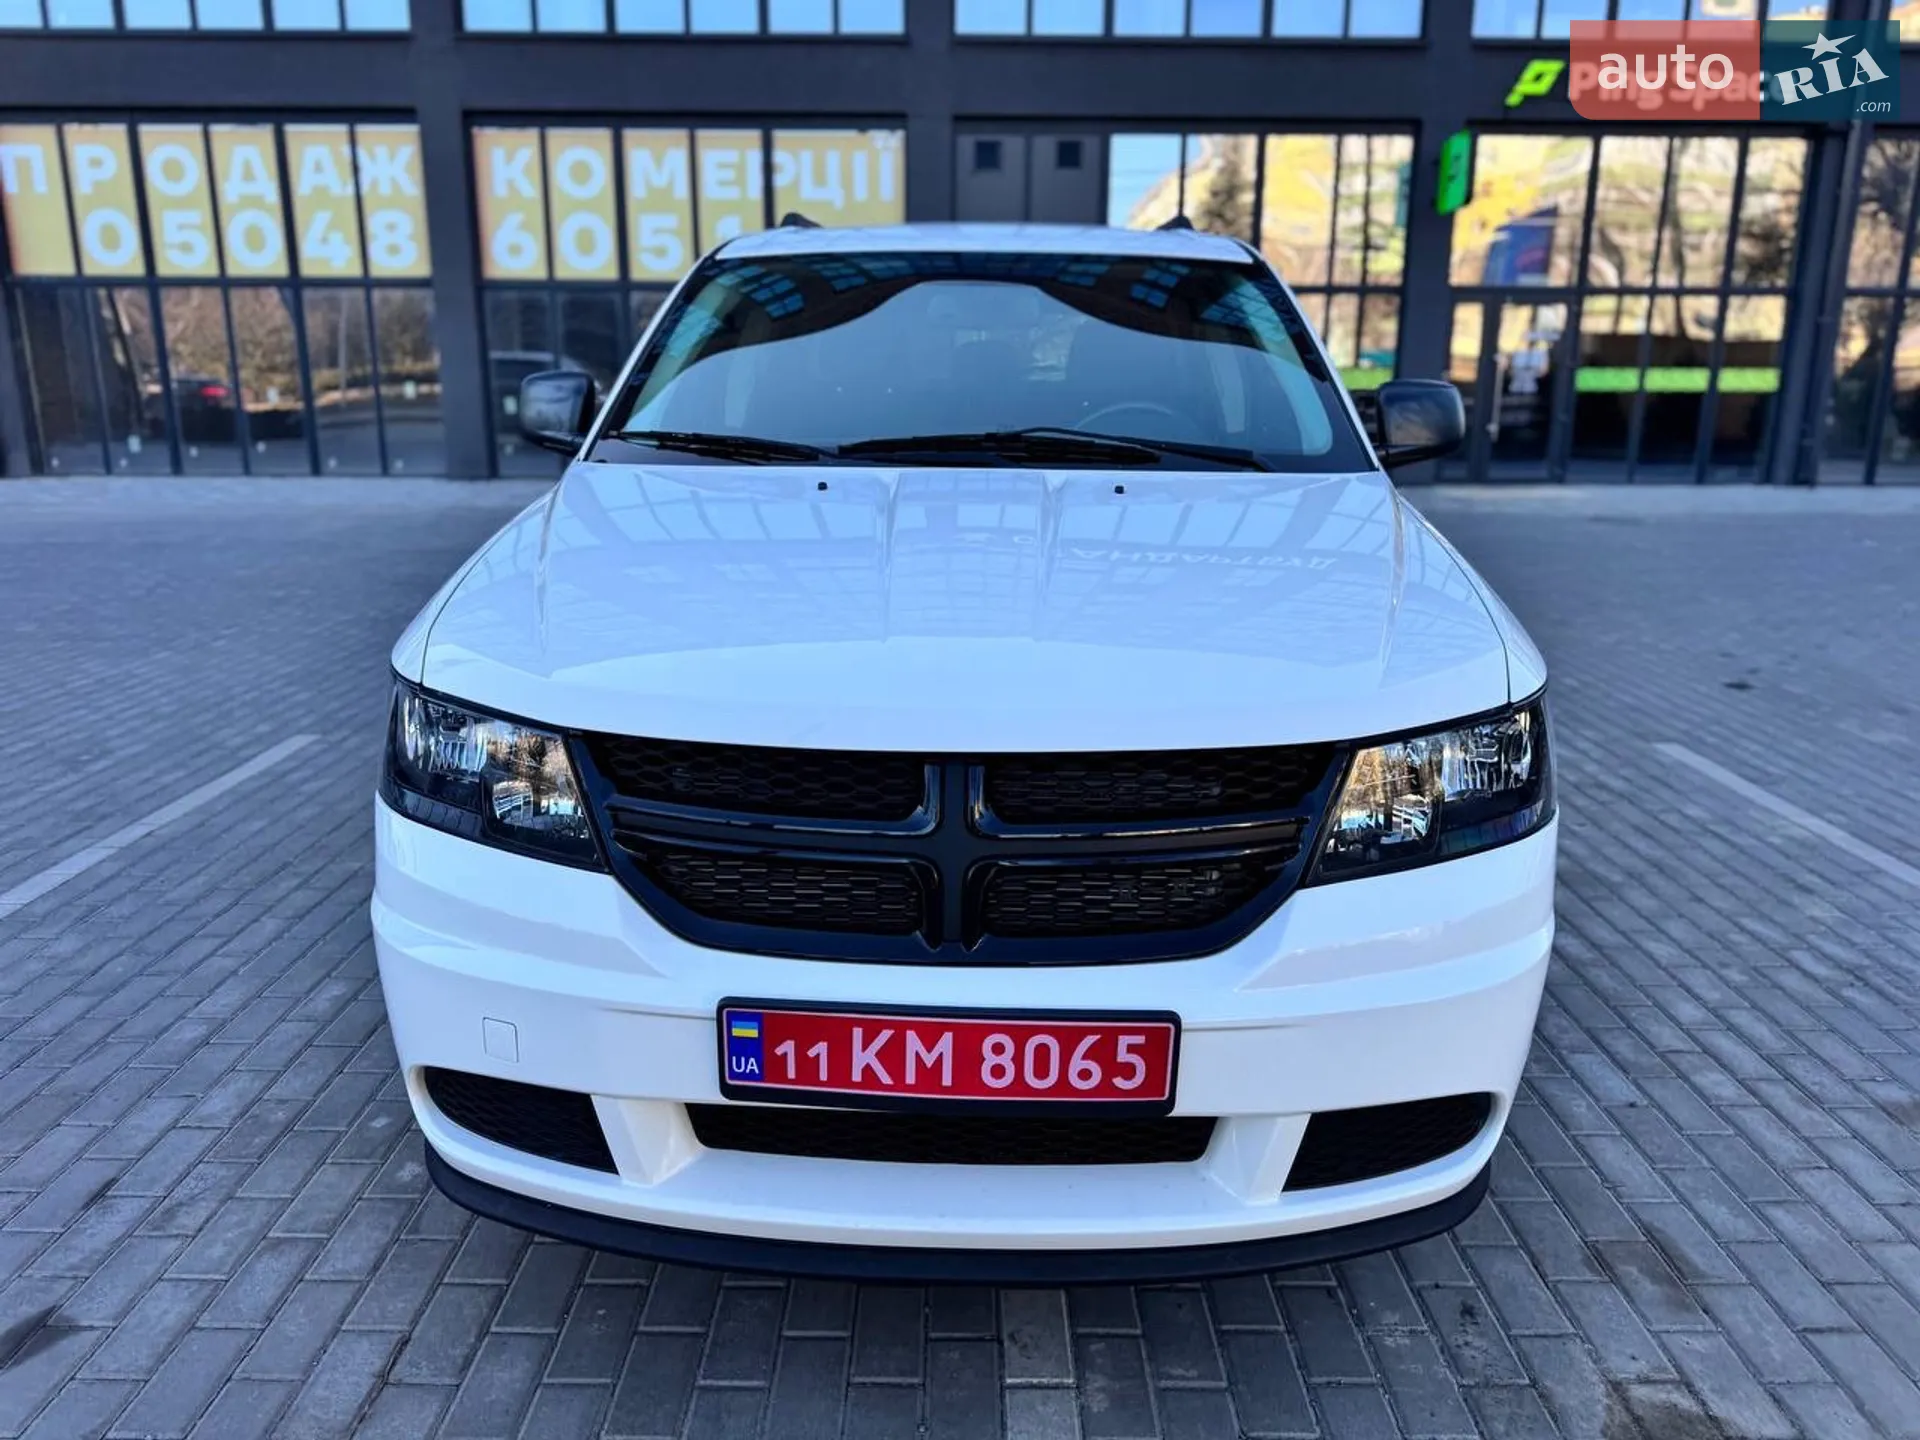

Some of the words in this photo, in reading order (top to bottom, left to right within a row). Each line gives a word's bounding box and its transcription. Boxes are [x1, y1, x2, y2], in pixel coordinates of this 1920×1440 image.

[1, 143, 419, 205] ПРОДАЖ
[489, 144, 898, 209] КОМЕРЦІЇ
[82, 208, 419, 269] 05048
[731, 1056, 759, 1075] UA
[774, 1039, 829, 1082] 11
[851, 1027, 953, 1087] KM
[980, 1033, 1146, 1091] 8065
